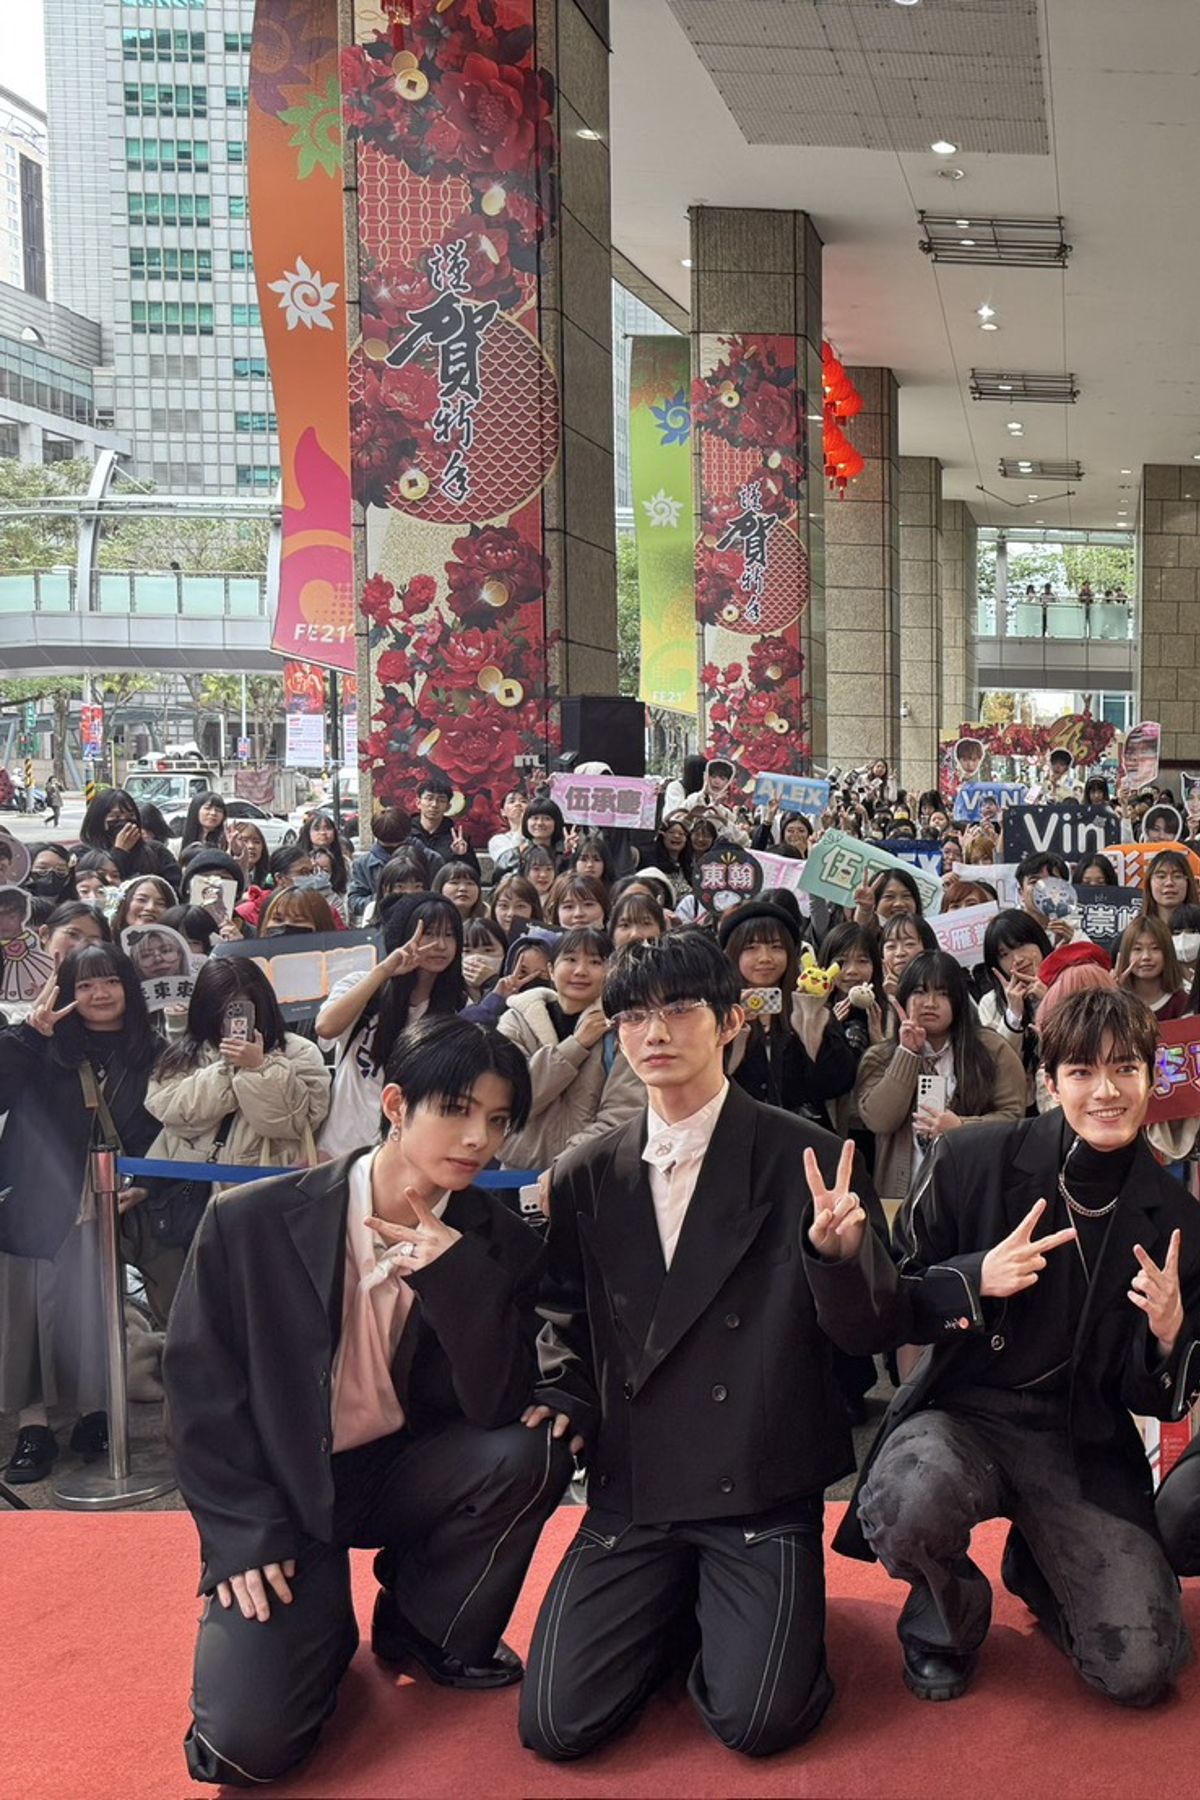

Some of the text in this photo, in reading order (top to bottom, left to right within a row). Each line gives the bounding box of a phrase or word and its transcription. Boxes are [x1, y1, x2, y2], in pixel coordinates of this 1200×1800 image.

[758, 778, 825, 807] ALEX
[1024, 812, 1106, 853] Vin
[701, 863, 755, 891] 東翰
